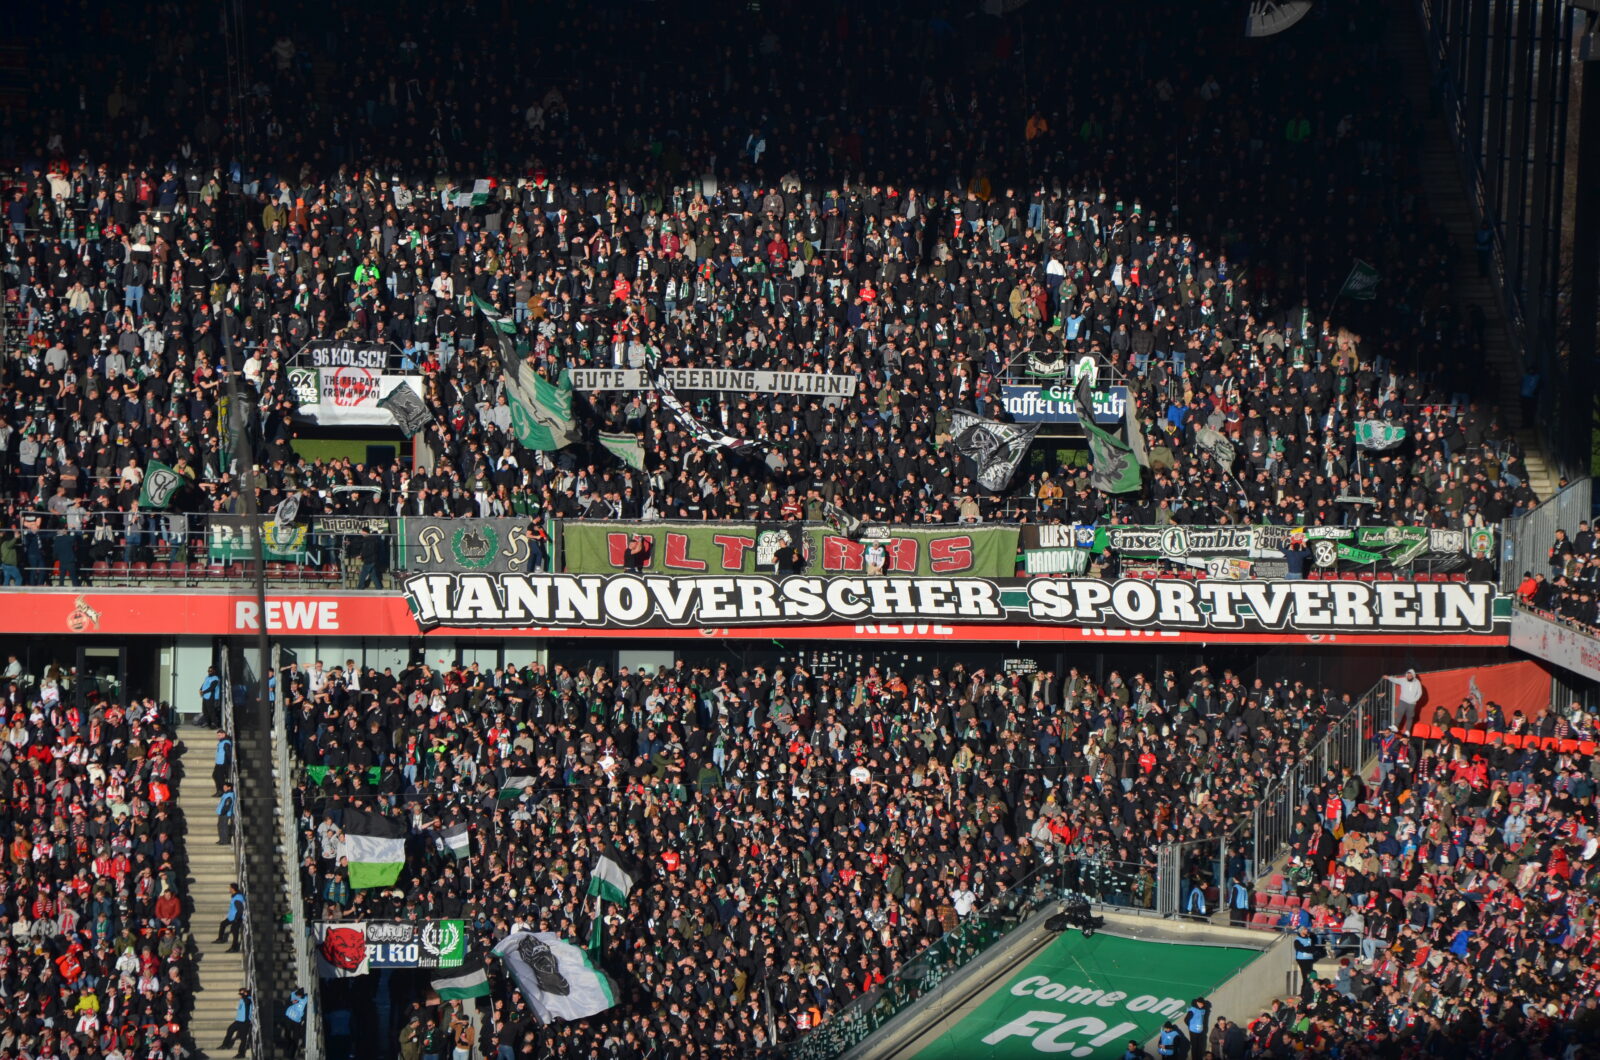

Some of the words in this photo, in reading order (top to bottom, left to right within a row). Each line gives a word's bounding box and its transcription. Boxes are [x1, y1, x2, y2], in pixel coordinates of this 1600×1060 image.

[313, 350, 328, 366] 96
[332, 343, 387, 368] KÖLSCH
[324, 375, 339, 386] THE
[573, 371, 625, 389] GUTE
[768, 373, 849, 394] JULIAN!
[1039, 524, 1075, 548] WEST
[1027, 549, 1087, 573] HANNOVR
[1210, 558, 1229, 579] 96
[408, 575, 1000, 625] HANNOVERSCHER
[1029, 578, 1490, 627] SPORTVEREIN
[235, 601, 339, 630] REWE
[981, 1010, 1139, 1058] FC!
